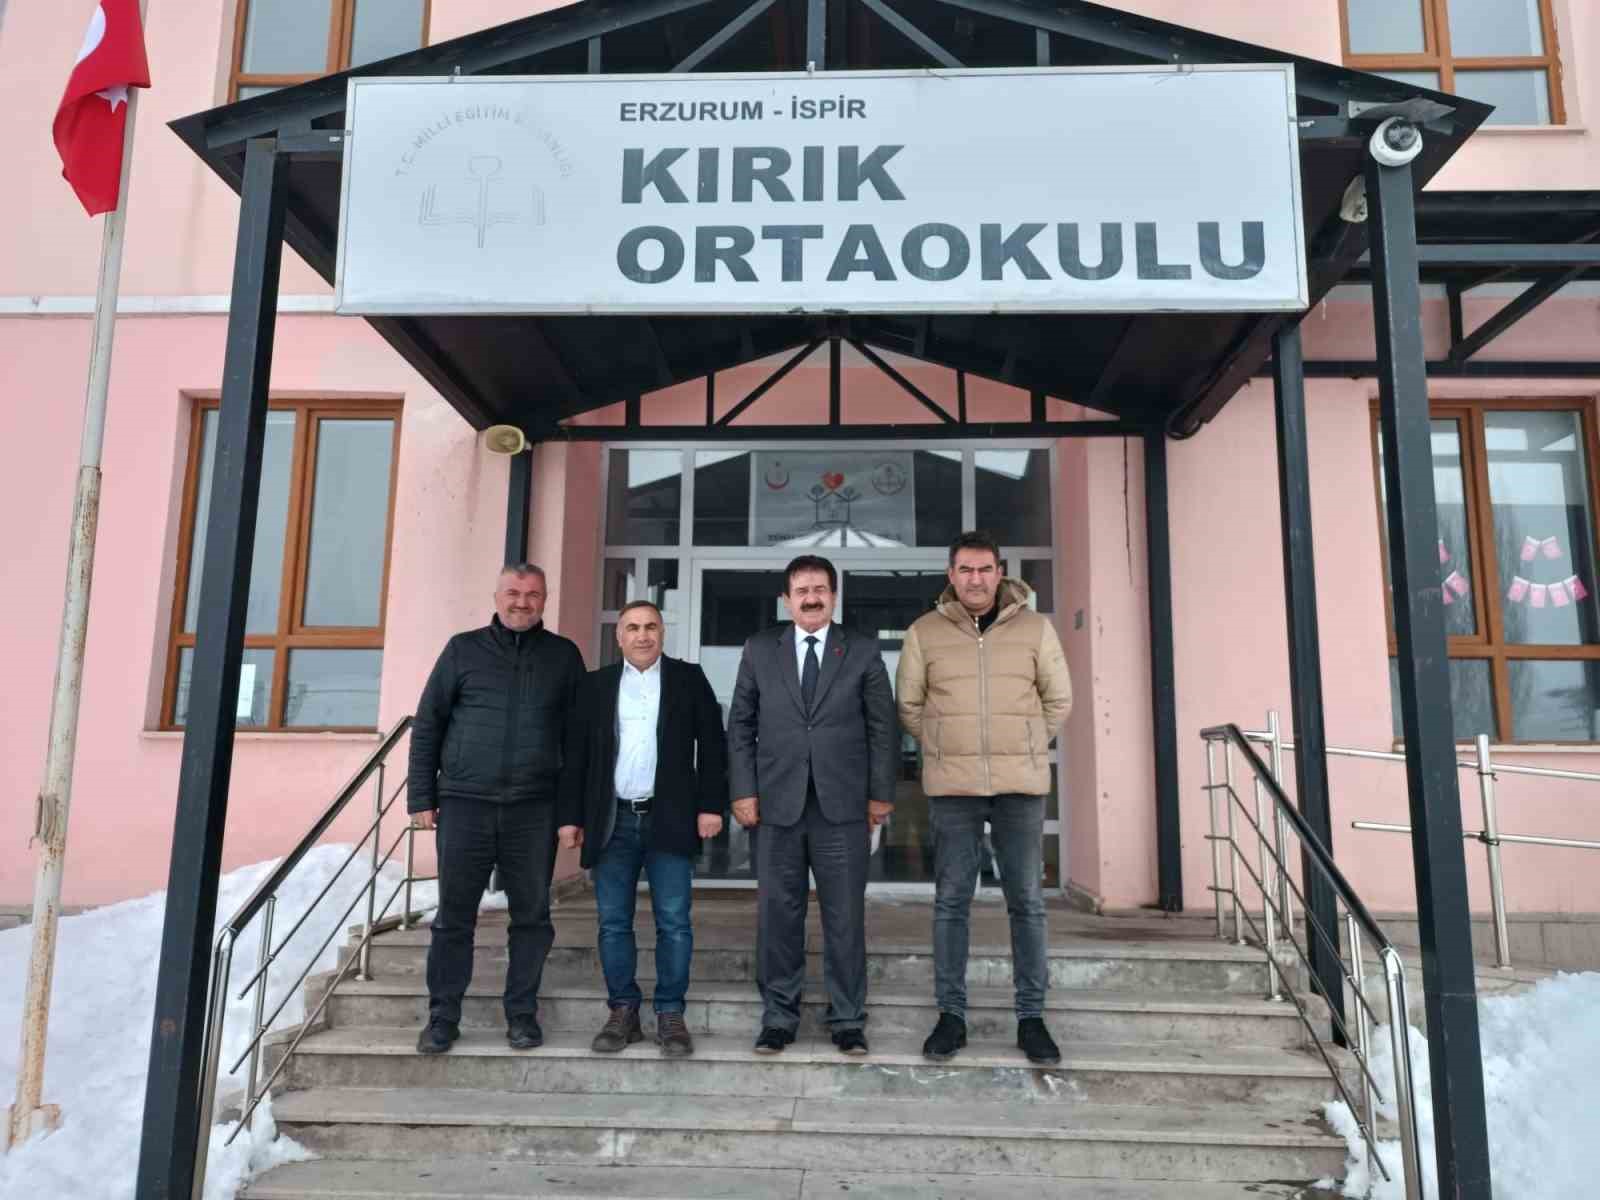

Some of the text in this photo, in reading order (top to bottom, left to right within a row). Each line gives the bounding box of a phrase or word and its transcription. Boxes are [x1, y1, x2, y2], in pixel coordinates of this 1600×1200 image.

[620, 100, 763, 122] ERZURUM
[791, 94, 867, 120] İSPİR
[620, 144, 907, 205] KIRIK
[616, 220, 1266, 285] ORTAOKULU
